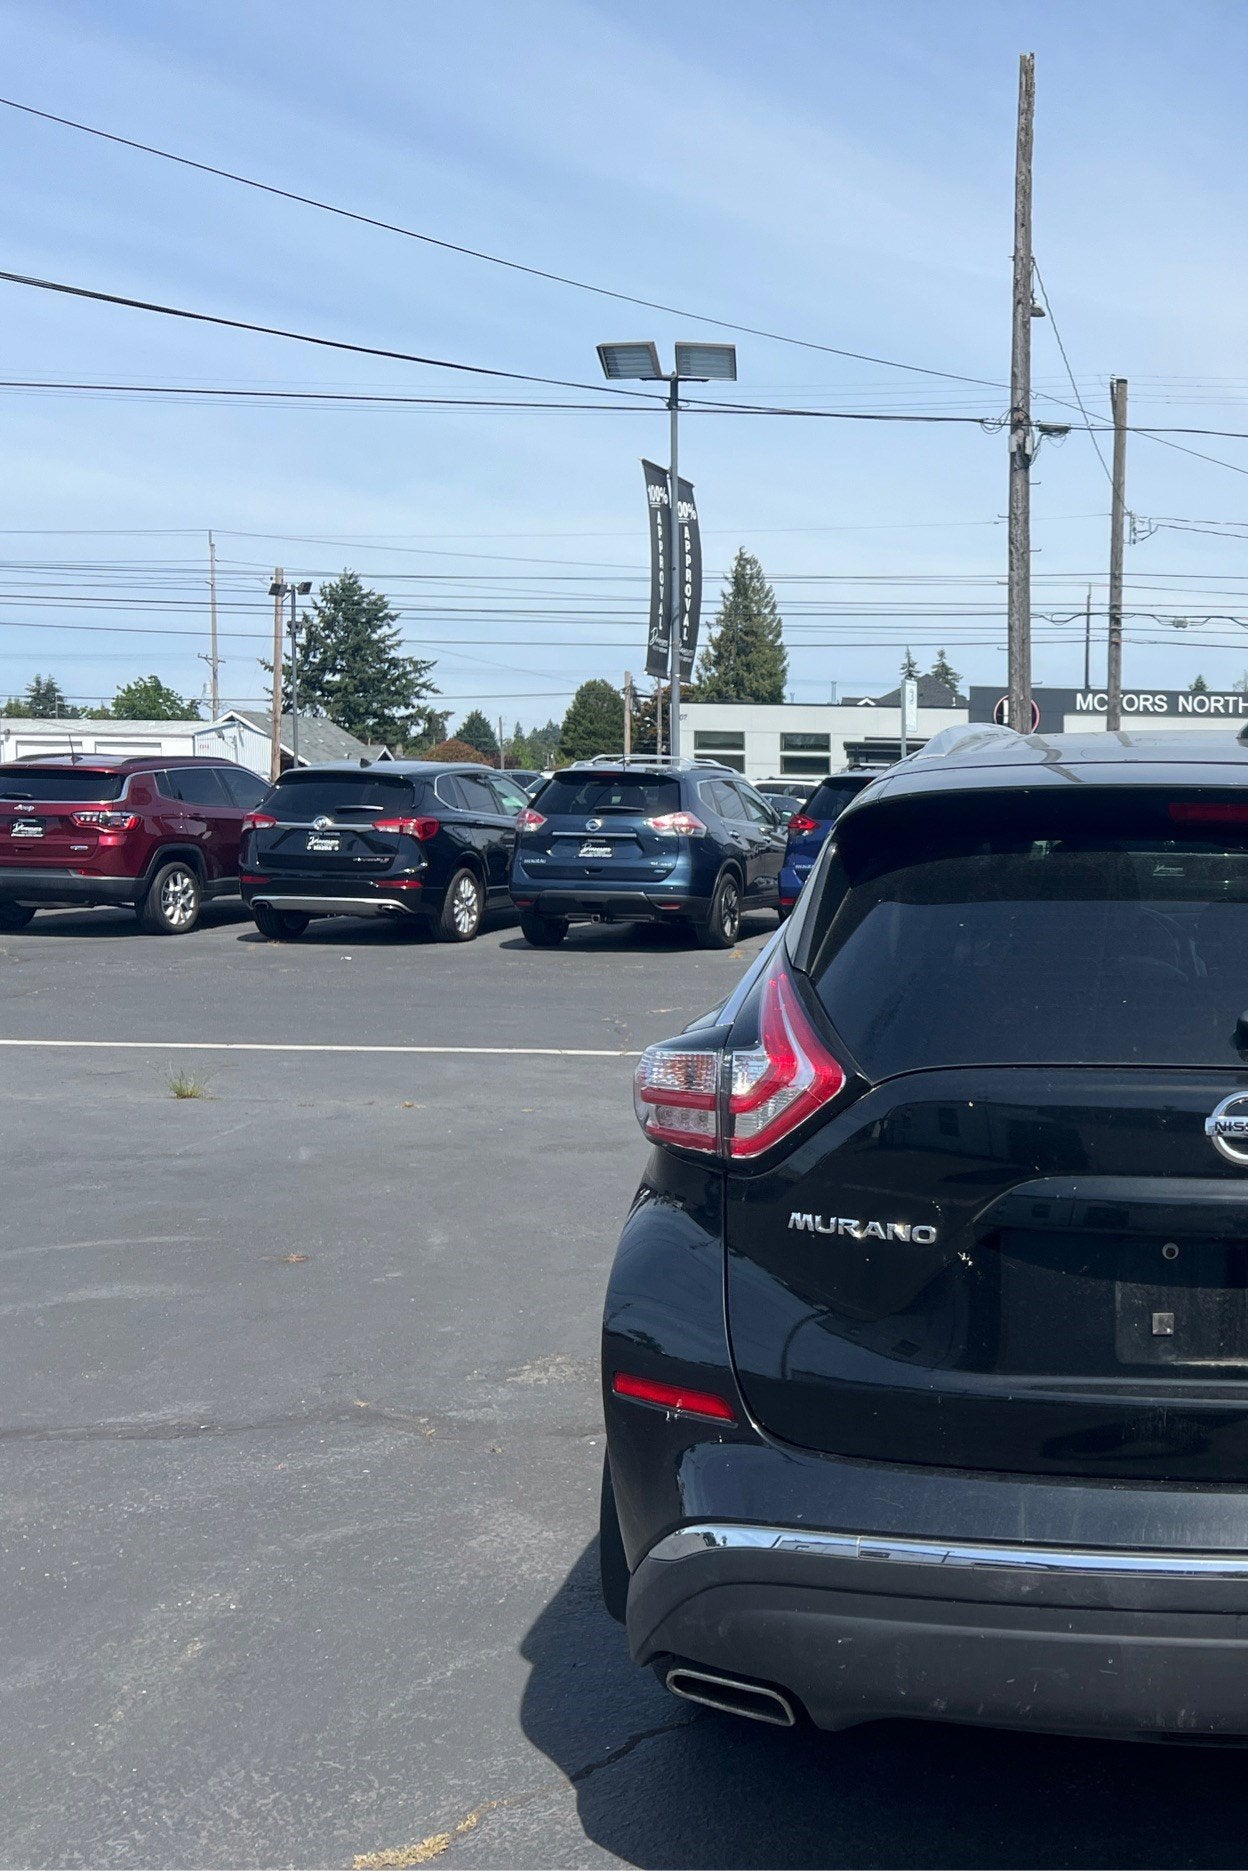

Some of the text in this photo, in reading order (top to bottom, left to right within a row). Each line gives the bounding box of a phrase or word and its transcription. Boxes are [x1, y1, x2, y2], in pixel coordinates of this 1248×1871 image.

[648, 485, 668, 504] 100%
[677, 501, 697, 520] 00%
[656, 511, 665, 630] APPROVAL
[683, 526, 692, 641] APPROVAL
[1076, 692, 1168, 712] MOORS
[787, 1212, 937, 1245] MURANO
